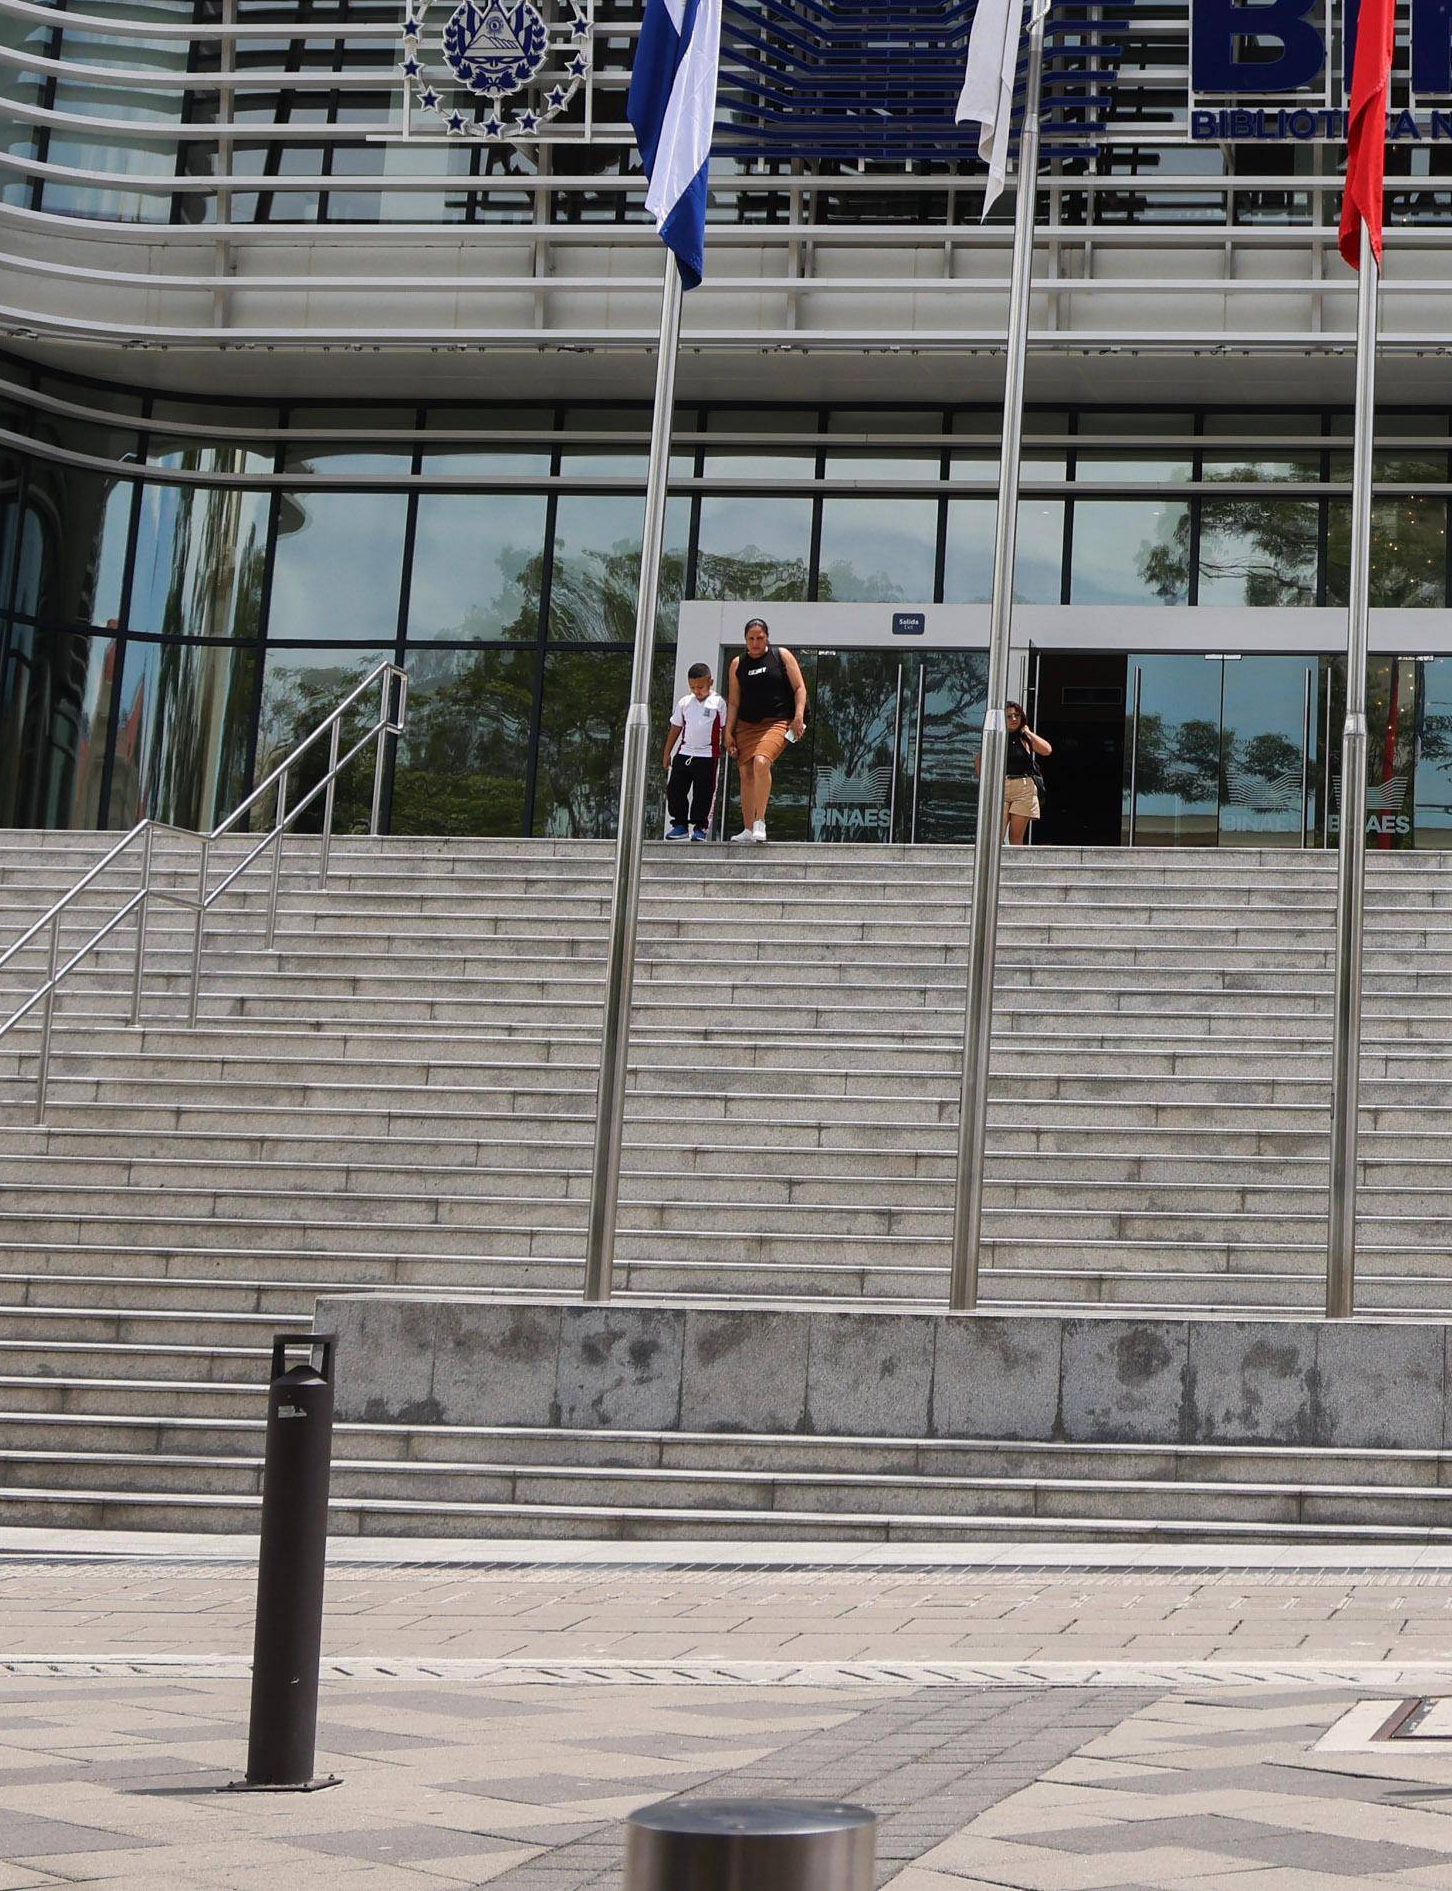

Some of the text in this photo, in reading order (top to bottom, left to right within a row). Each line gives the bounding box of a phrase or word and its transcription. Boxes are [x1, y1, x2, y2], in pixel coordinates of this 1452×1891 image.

[1191, 109, 1422, 140] BIBLIOTA
[811, 808, 891, 827] BINAES
[1327, 814, 1411, 833] BAES
